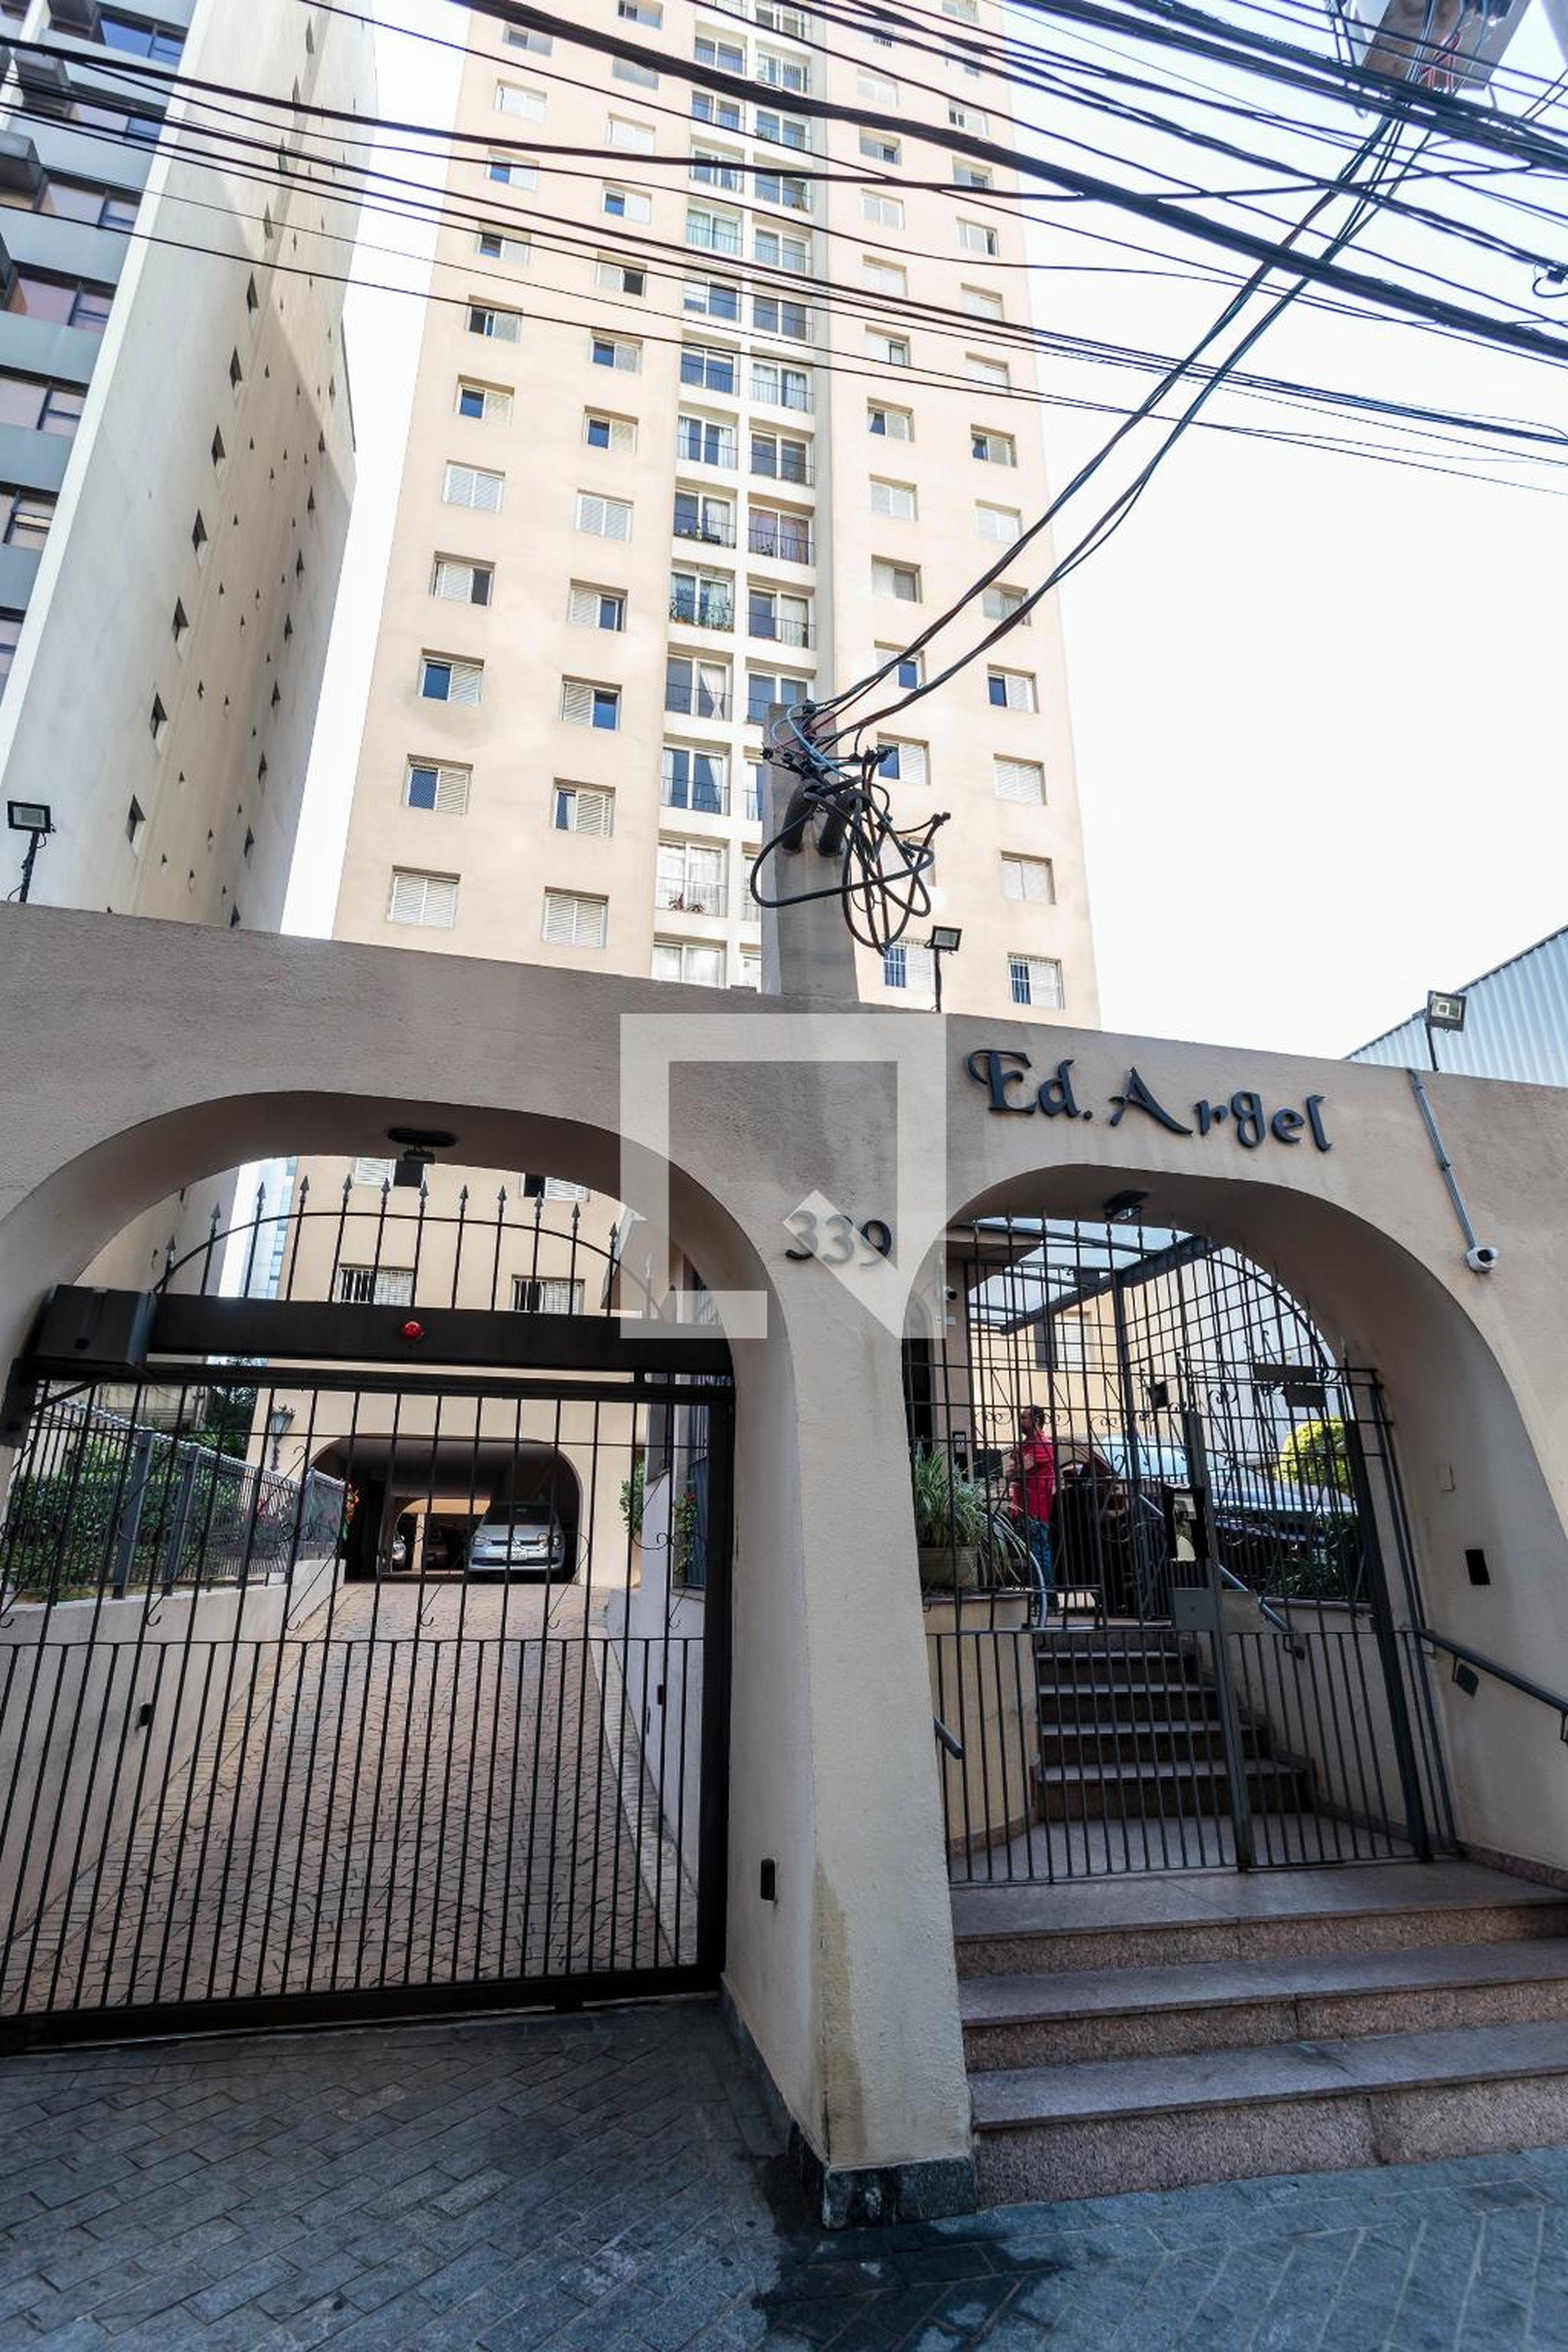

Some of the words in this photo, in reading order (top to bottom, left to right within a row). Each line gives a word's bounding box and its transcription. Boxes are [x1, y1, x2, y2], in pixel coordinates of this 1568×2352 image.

[967, 1049, 1093, 1120] Ed.
[1108, 1067, 1331, 1152] Argel
[784, 1210, 892, 1267] 339
